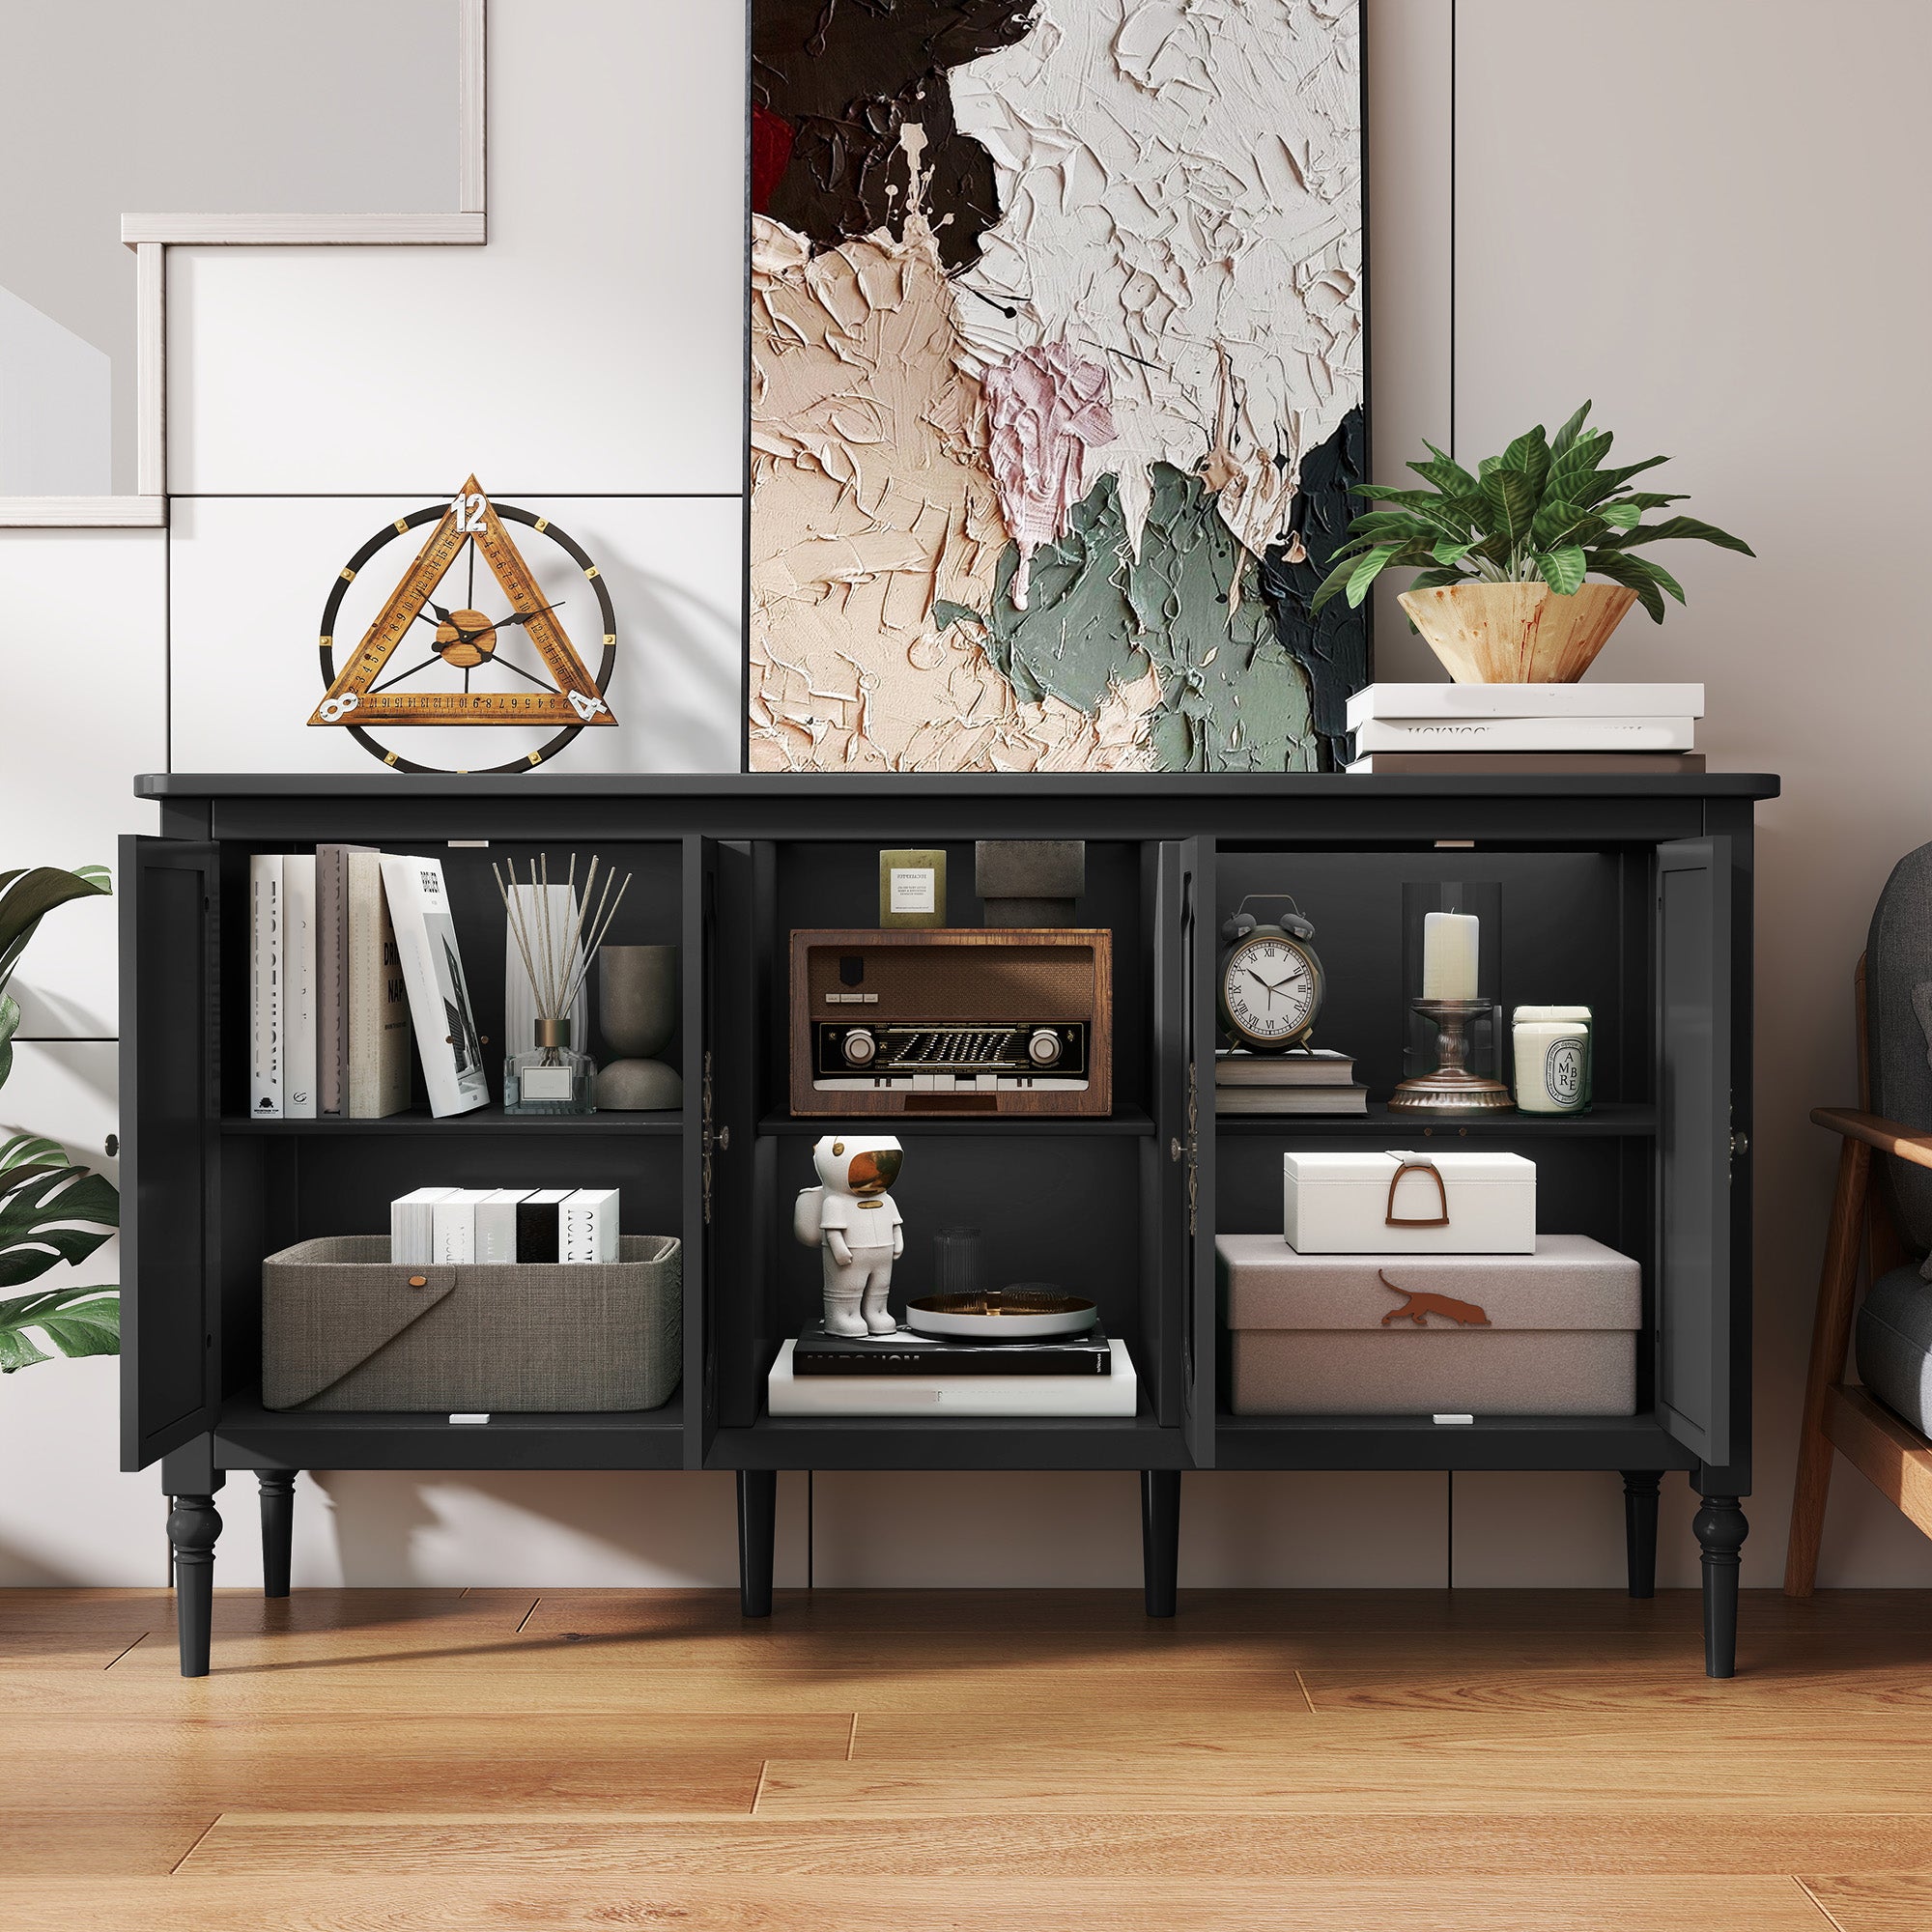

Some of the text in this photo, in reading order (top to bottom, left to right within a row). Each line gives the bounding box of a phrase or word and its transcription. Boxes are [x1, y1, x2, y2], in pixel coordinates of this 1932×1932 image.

[451, 493, 487, 532] 12
[370, 654, 379, 664] 5
[376, 643, 386, 652] 6
[383, 634, 392, 642] 7
[389, 623, 400, 632] 8
[396, 612, 407, 621] 9
[402, 602, 413, 611] 10
[410, 590, 421, 601] 11
[416, 581, 428, 591] 12
[423, 570, 434, 581] 13
[429, 560, 441, 571] 14
[437, 550, 448, 560] 15
[443, 539, 455, 550] 16
[514, 592, 525, 601] 9
[519, 602, 531, 612] 10
[530, 622, 543, 634] 12
[537, 633, 550, 643] 13
[543, 643, 554, 654] 14
[550, 655, 561, 665] 15
[555, 665, 567, 674] 16
[562, 675, 574, 685] 17
[369, 697, 378, 708] 17
[382, 697, 390, 708] 16
[394, 697, 403, 707] 15
[408, 697, 416, 707] 14
[420, 697, 429, 707] 13
[433, 697, 441, 707] 12
[446, 697, 454, 707] 11
[459, 697, 468, 708] 10
[472, 698, 479, 709] 9
[486, 698, 492, 708] 8
[498, 698, 505, 708] 7
[511, 698, 518, 708] 6
[525, 698, 531, 708] 5
[538, 698, 544, 708] 4
[550, 698, 555, 708] 3
[567, 689, 608, 722] 4
[319, 692, 358, 723] 8
[1247, 952, 1258, 964] XI
[1264, 949, 1275, 957] XII
[1283, 953, 1289, 962] I
[1236, 966, 1246, 976] X
[1293, 966, 1302, 975] II
[1233, 985, 1241, 994] IX
[1237, 999, 1249, 1015] VIII
[1293, 1001, 1303, 1011] IV
[1248, 1013, 1260, 1026] VII
[1282, 1014, 1290, 1024] V
[1265, 1020, 1274, 1029] VI
